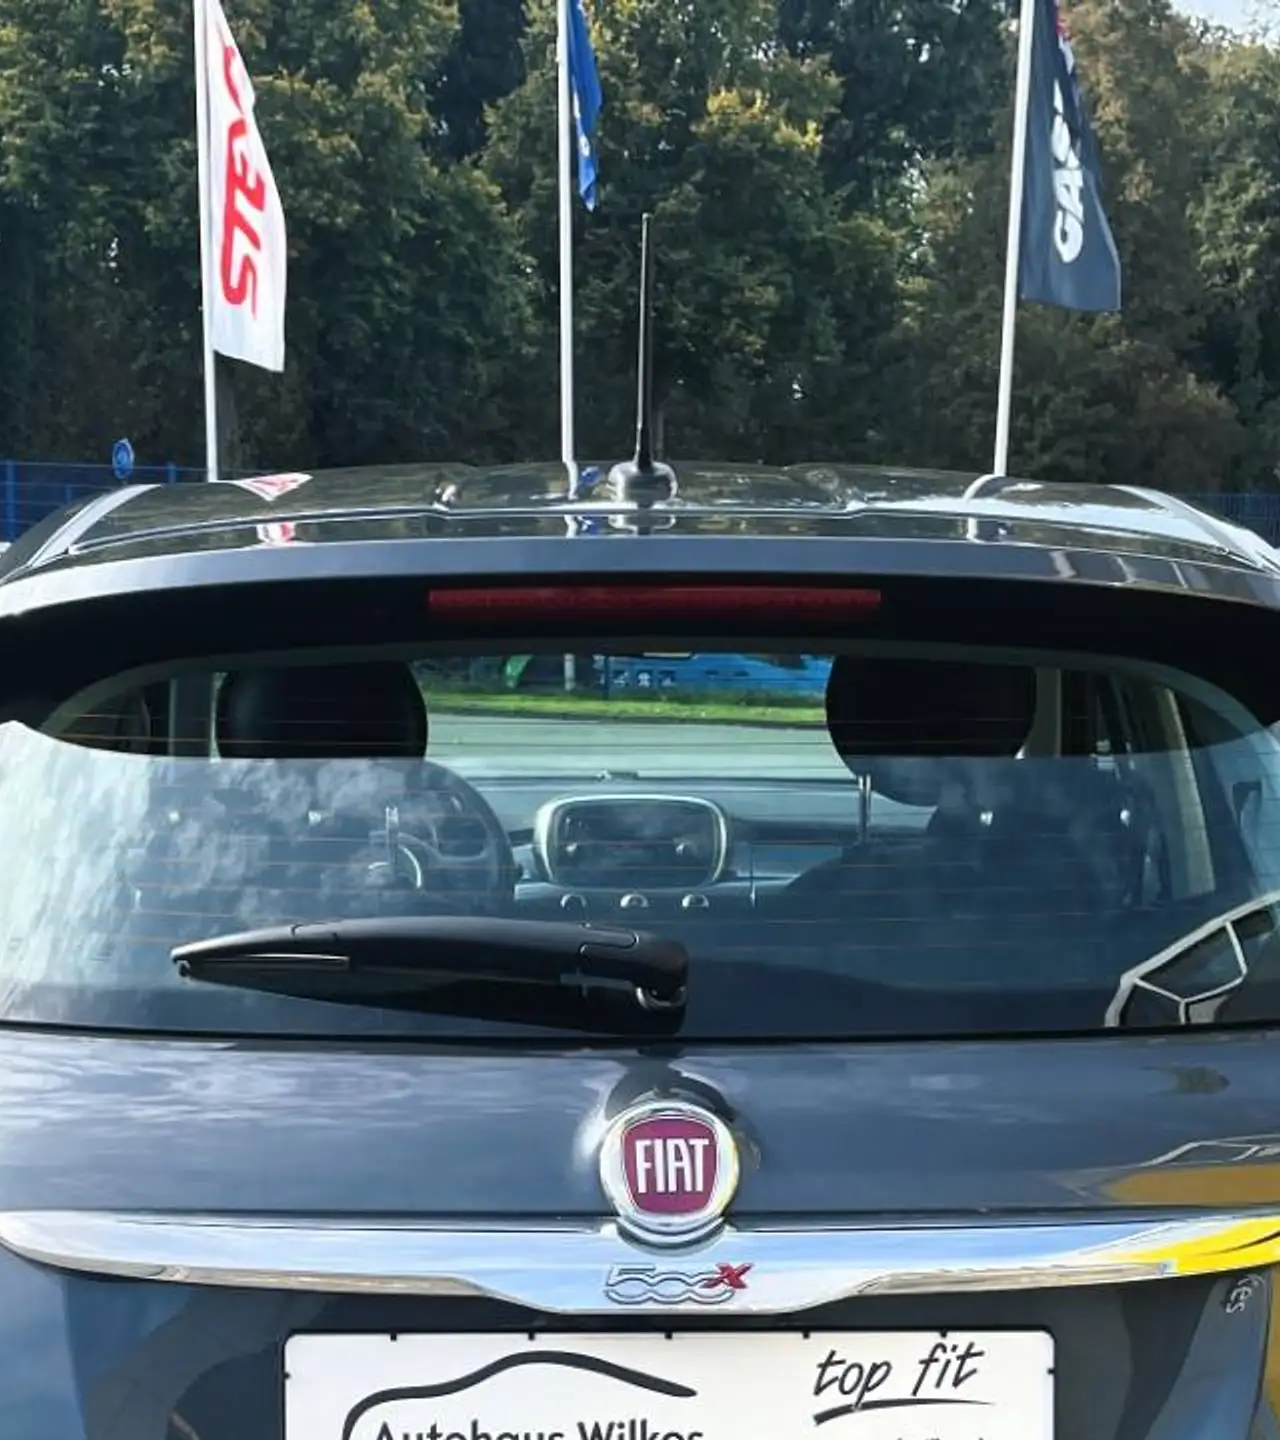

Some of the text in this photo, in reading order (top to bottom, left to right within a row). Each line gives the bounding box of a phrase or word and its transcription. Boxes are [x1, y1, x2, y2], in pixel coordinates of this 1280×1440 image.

[634, 1137, 710, 1194] FIAT
[813, 1341, 986, 1409] top fit
